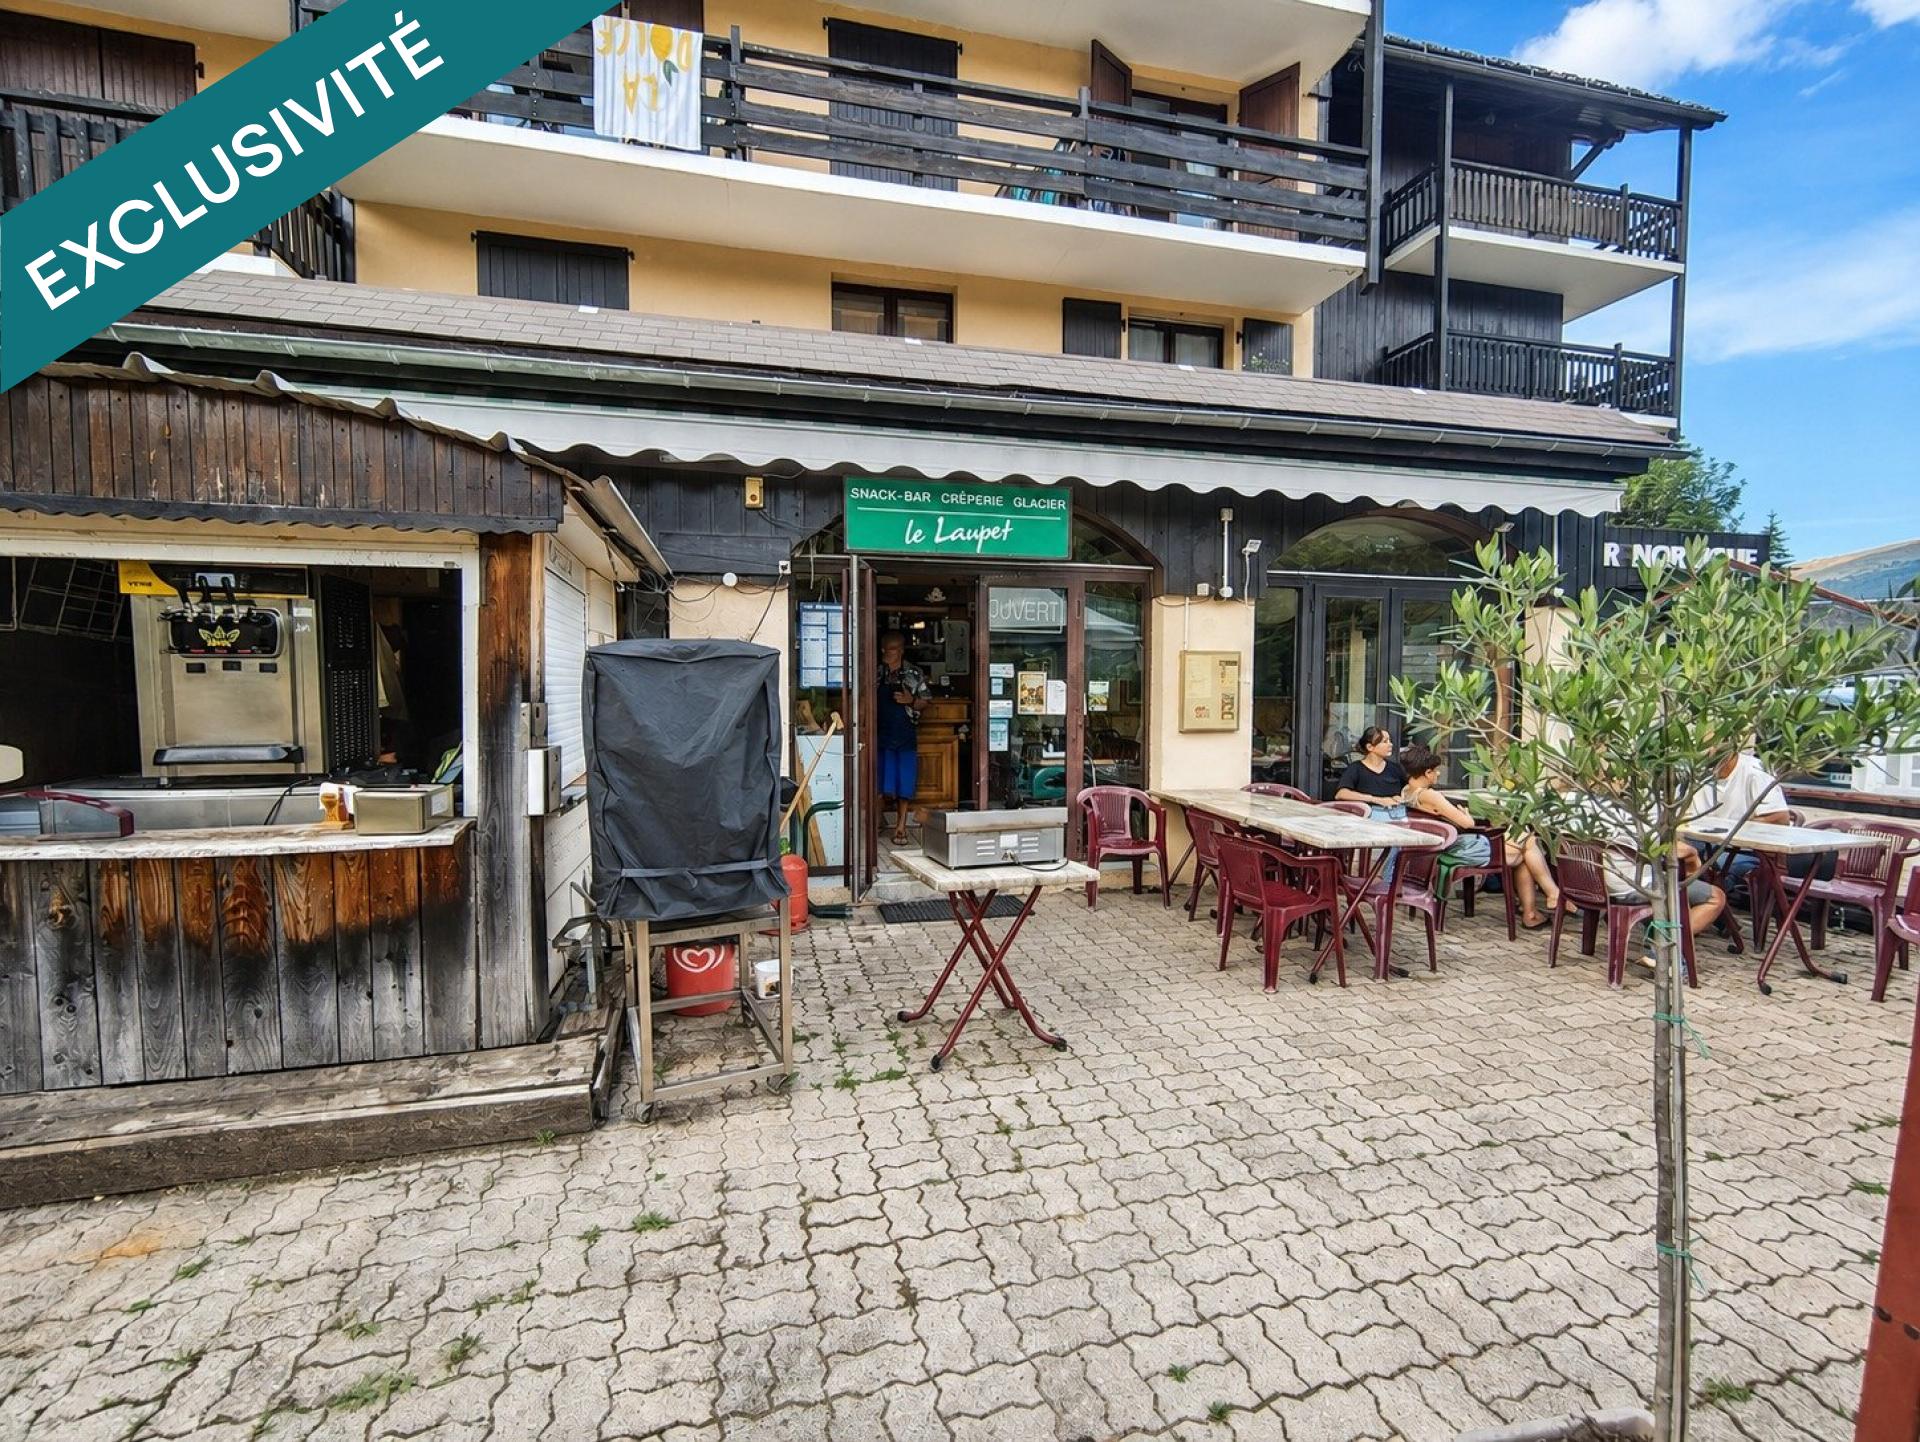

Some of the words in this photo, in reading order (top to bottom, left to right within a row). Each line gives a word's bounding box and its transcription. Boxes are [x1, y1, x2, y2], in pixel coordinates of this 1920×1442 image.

[850, 487, 931, 502] SNACK-BAR
[941, 490, 1004, 507] CRÊPERIE
[1013, 496, 1066, 510] GLACIER
[904, 519, 926, 545] le
[933, 516, 1013, 553] Laupet
[989, 598, 1060, 622] OUVERT
